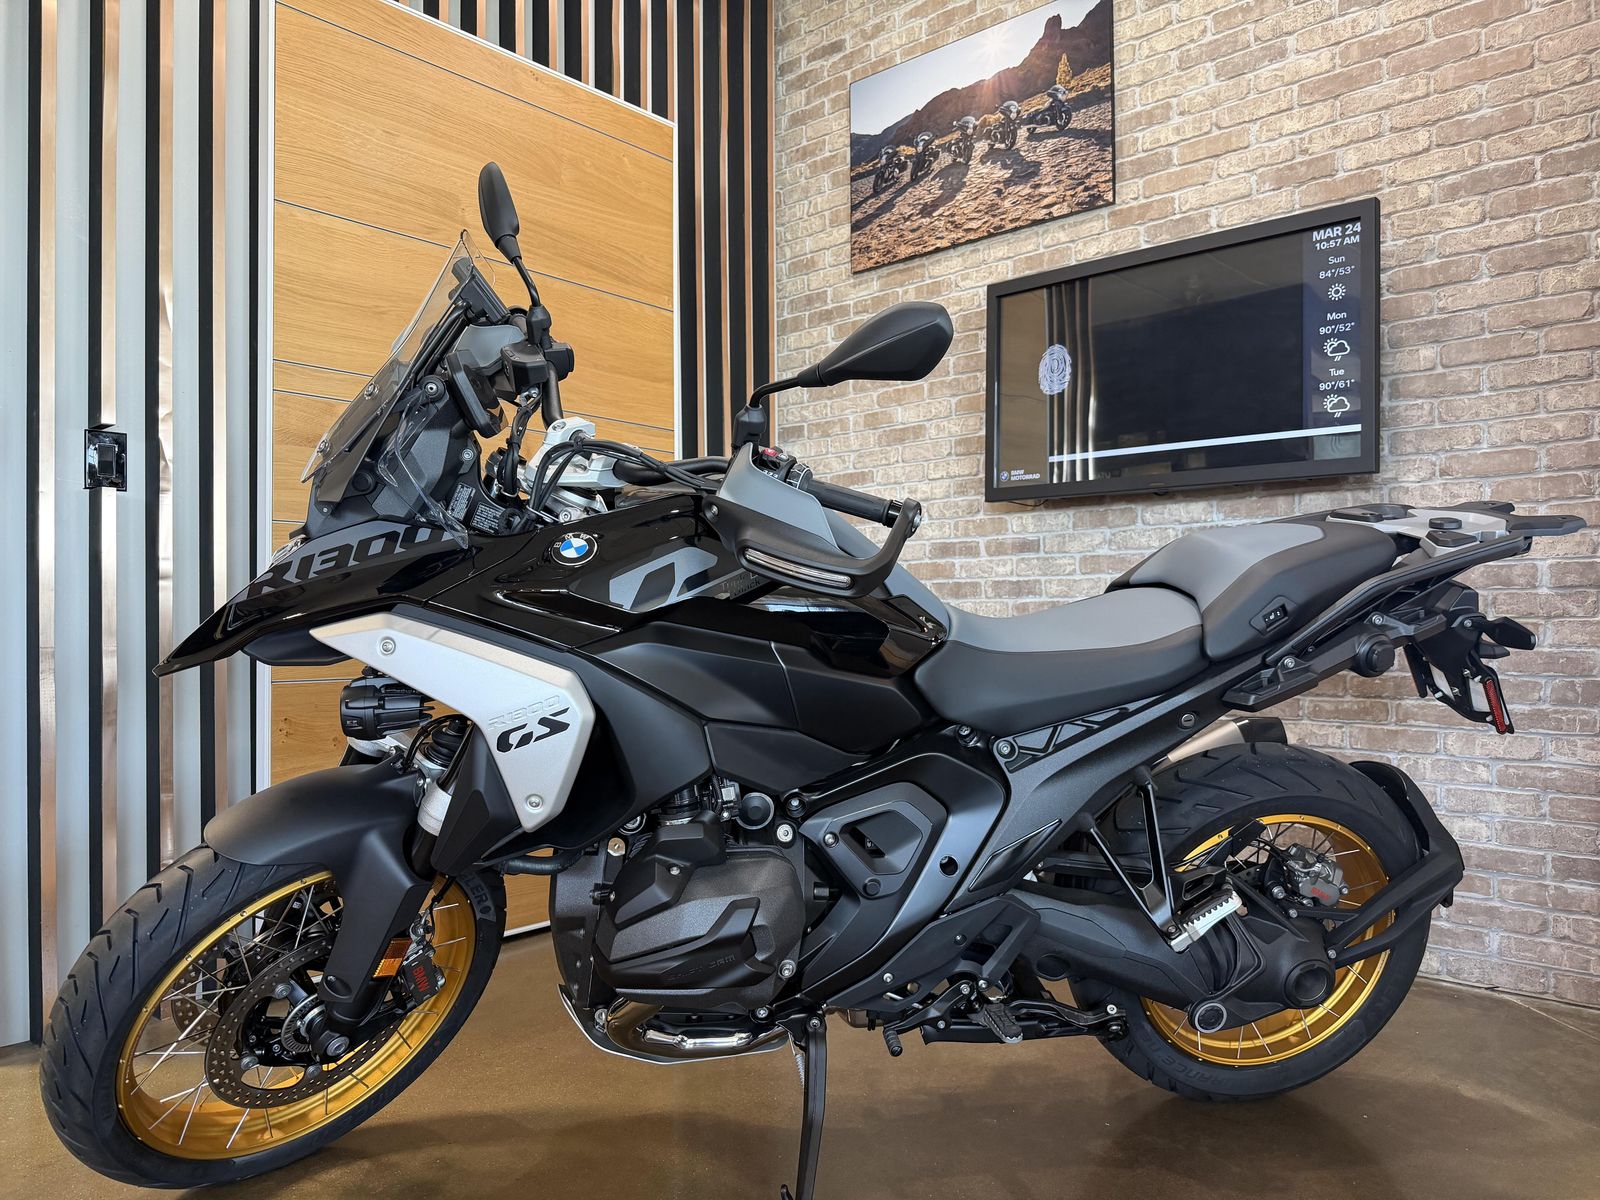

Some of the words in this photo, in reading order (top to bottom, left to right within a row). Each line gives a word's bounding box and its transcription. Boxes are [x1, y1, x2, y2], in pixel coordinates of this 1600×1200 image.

[1312, 226, 1342, 242] MAR
[1345, 222, 1361, 235] 24
[1315, 239, 1342, 250] 10:57
[1343, 235, 1360, 245] AM
[1328, 255, 1346, 265] Sun
[1326, 312, 1347, 321] Mon
[1328, 368, 1345, 377] Tue
[1010, 473, 1041, 481] MOTORRAD
[553, 532, 590, 549] BMW
[496, 706, 571, 754] GS
[411, 966, 431, 993] BMW
